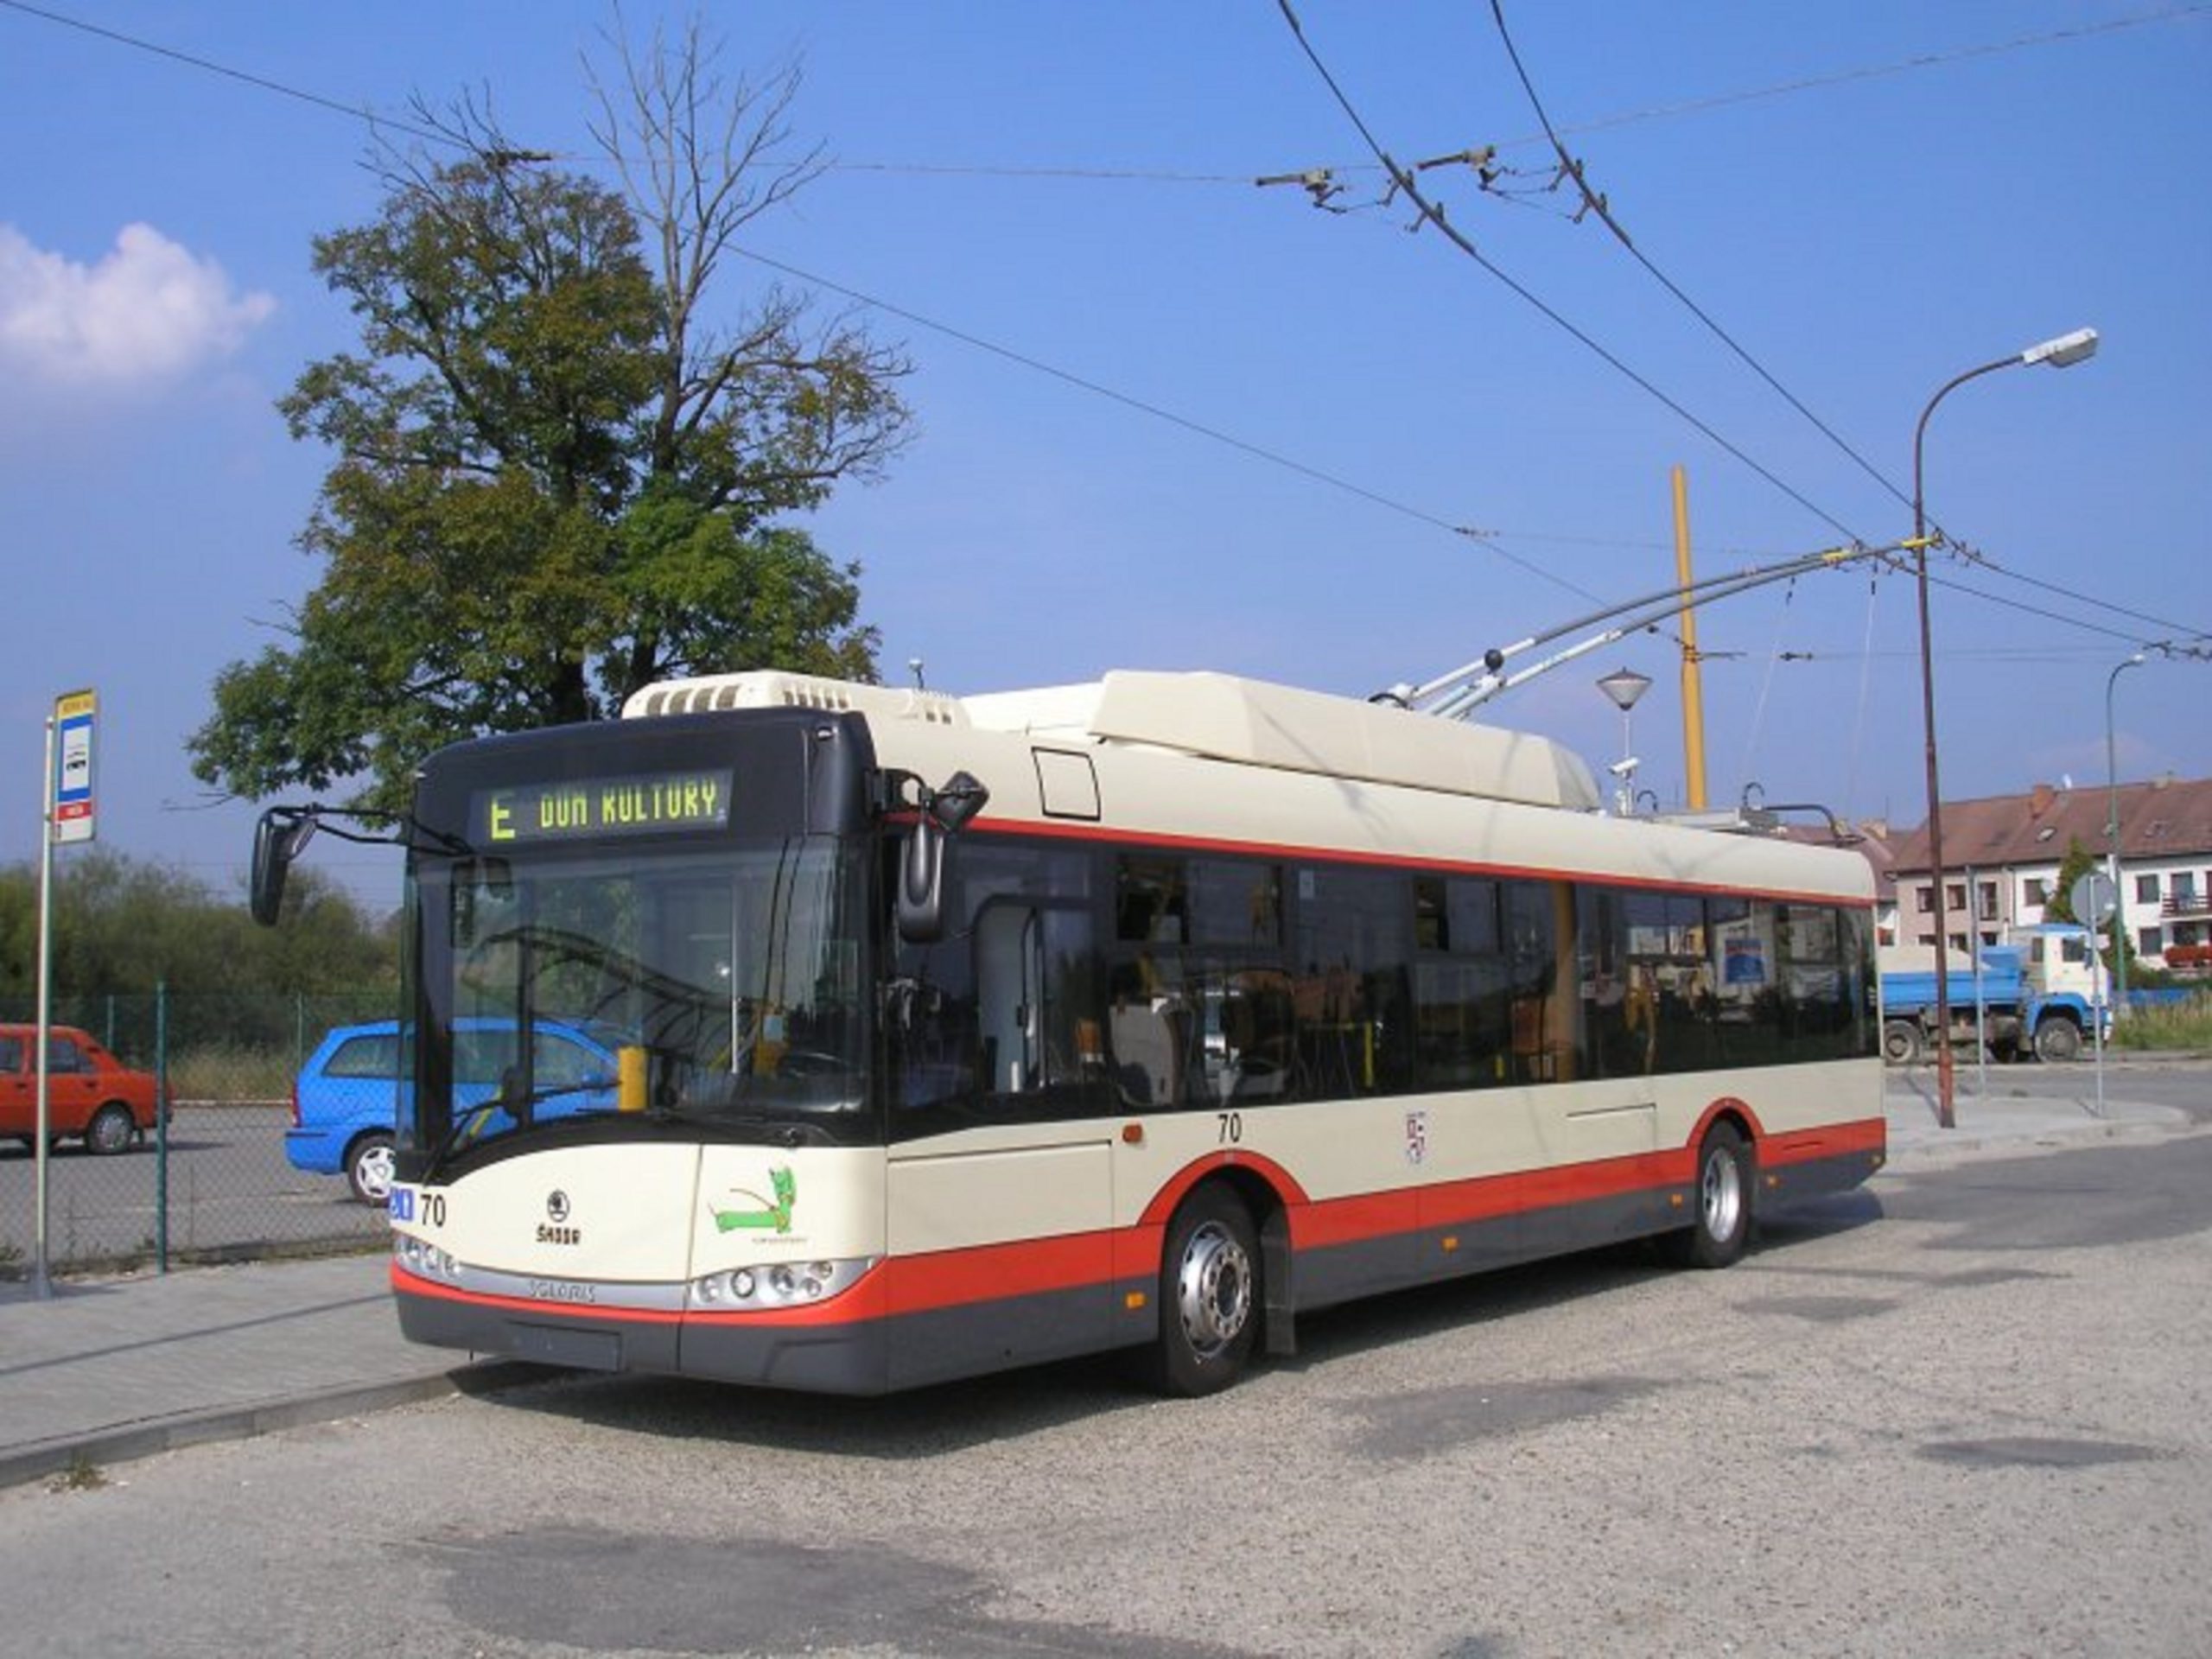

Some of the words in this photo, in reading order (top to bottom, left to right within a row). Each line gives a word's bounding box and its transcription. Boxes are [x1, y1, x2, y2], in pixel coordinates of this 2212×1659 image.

[602, 779, 717, 823] KULTURY
[1217, 1112, 1243, 1143] 70
[420, 1194, 446, 1228] 70
